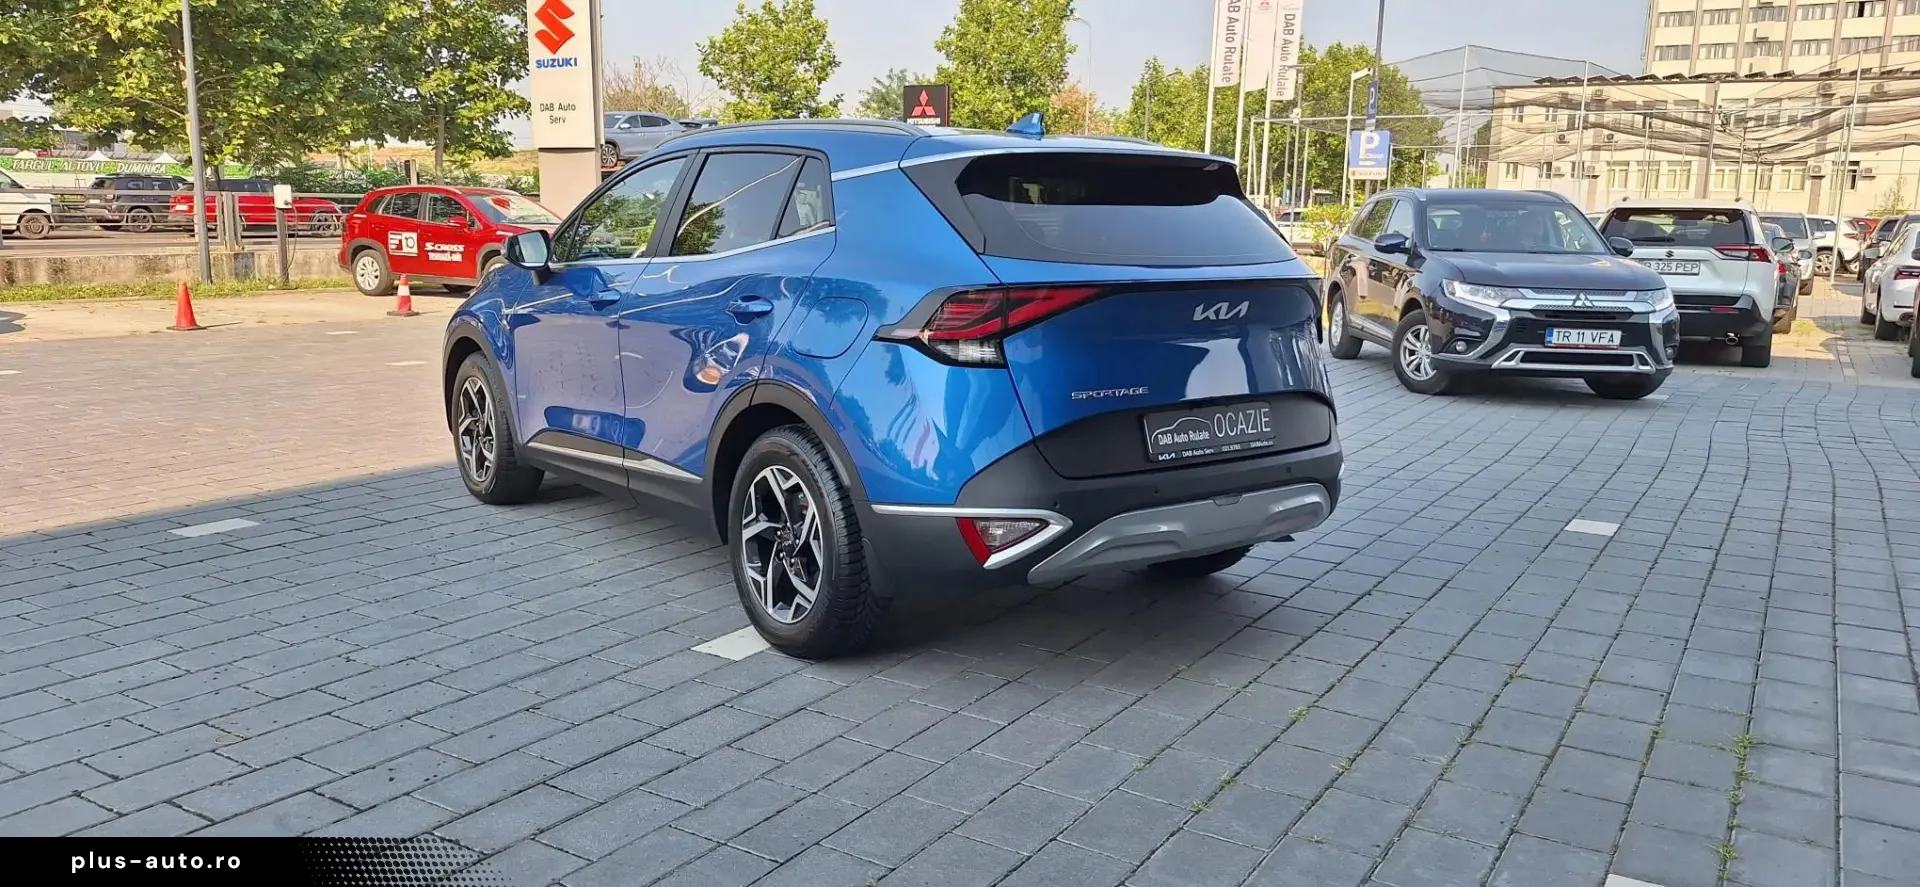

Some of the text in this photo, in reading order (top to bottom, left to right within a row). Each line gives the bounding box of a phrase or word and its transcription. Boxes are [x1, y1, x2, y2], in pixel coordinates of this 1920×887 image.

[1225, 16, 1239, 43] Auto
[1276, 13, 1296, 97] DAB Auto Rulate
[535, 57, 578, 69] SUZUKI
[1221, 47, 1236, 83] Rulate
[540, 102, 576, 112] DAB Auto
[549, 115, 567, 124] Serv
[1359, 131, 1381, 159] P
[117, 163, 166, 174] DUMINICA
[1654, 262, 1672, 271] 325
[1675, 262, 1699, 272] PEP
[1193, 301, 1249, 321] KIA
[1555, 330, 1614, 344] TR 11 VFA
[1071, 386, 1150, 400] SPORTAGE
[1214, 408, 1271, 438] OCAZIE
[1158, 429, 1210, 445] DAB Auto Rulate
[1182, 449, 1193, 458] DAB
[1193, 448, 1204, 456] Auto
